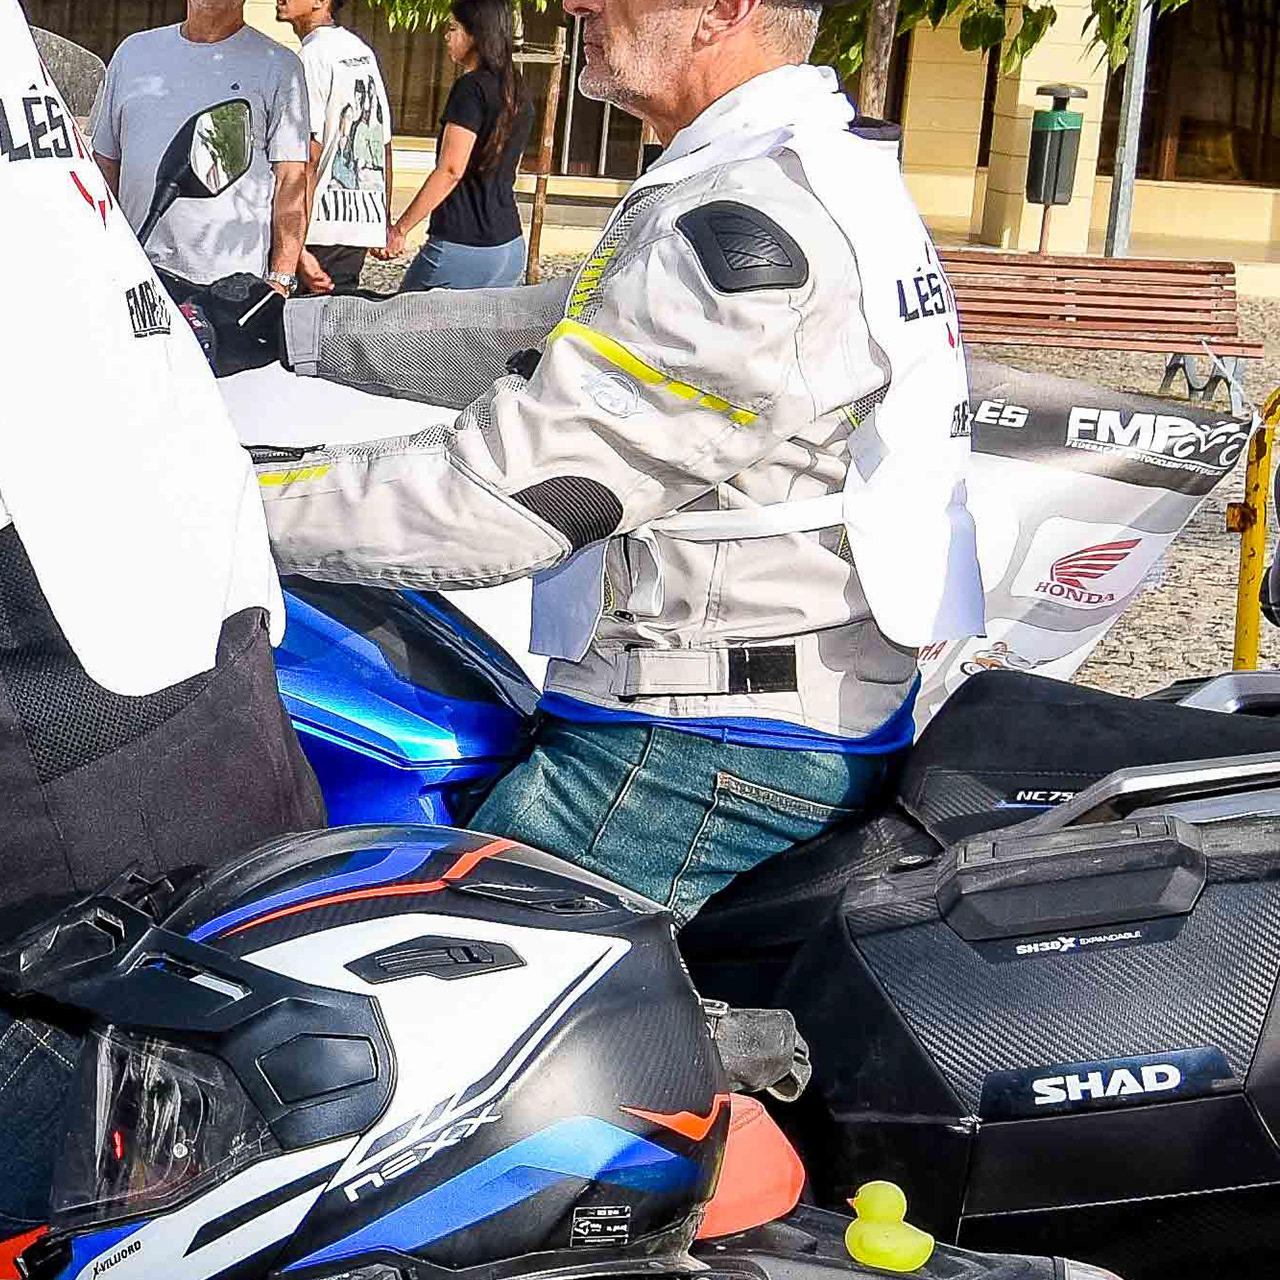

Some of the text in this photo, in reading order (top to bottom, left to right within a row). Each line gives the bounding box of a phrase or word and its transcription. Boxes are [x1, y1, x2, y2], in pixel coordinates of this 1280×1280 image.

[896, 266, 946, 322] LÉS
[974, 398, 1030, 428] ÉS
[1066, 406, 1196, 456] FMP
[1034, 581, 1115, 604] HONDA
[1032, 1063, 1181, 1106] SHAD
